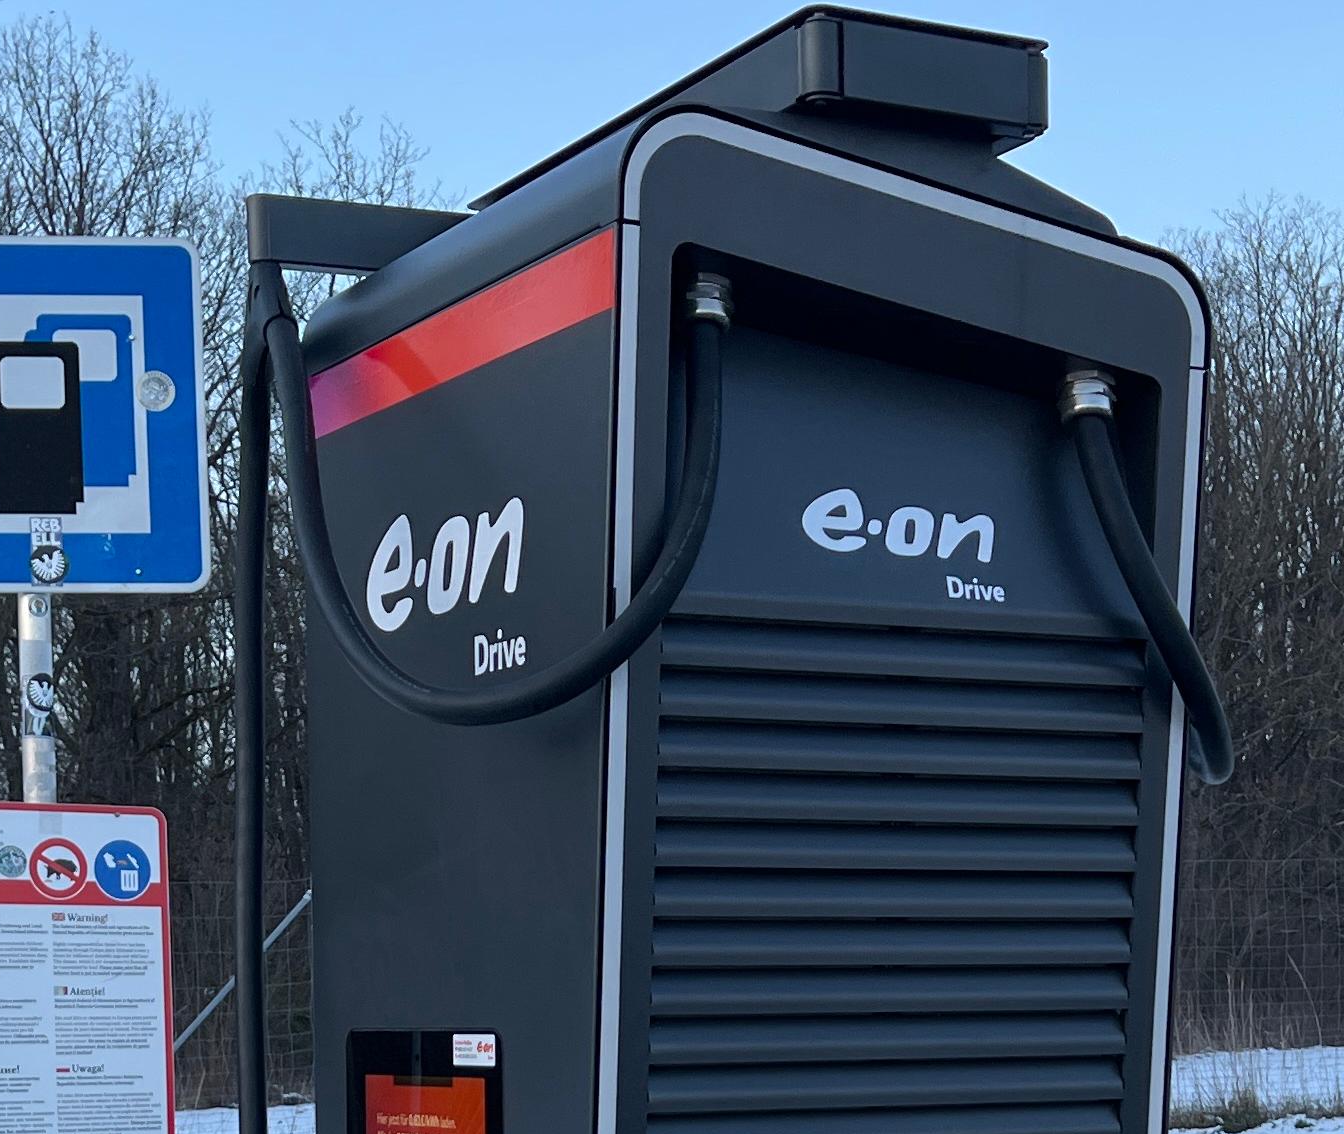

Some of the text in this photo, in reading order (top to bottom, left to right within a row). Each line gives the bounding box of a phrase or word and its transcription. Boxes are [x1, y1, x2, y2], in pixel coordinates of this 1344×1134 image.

[946, 575, 1006, 602] Drive
[474, 628, 527, 676] Drive
[67, 913, 108, 924] Warning!
[71, 1063, 105, 1074] Uwaga!
